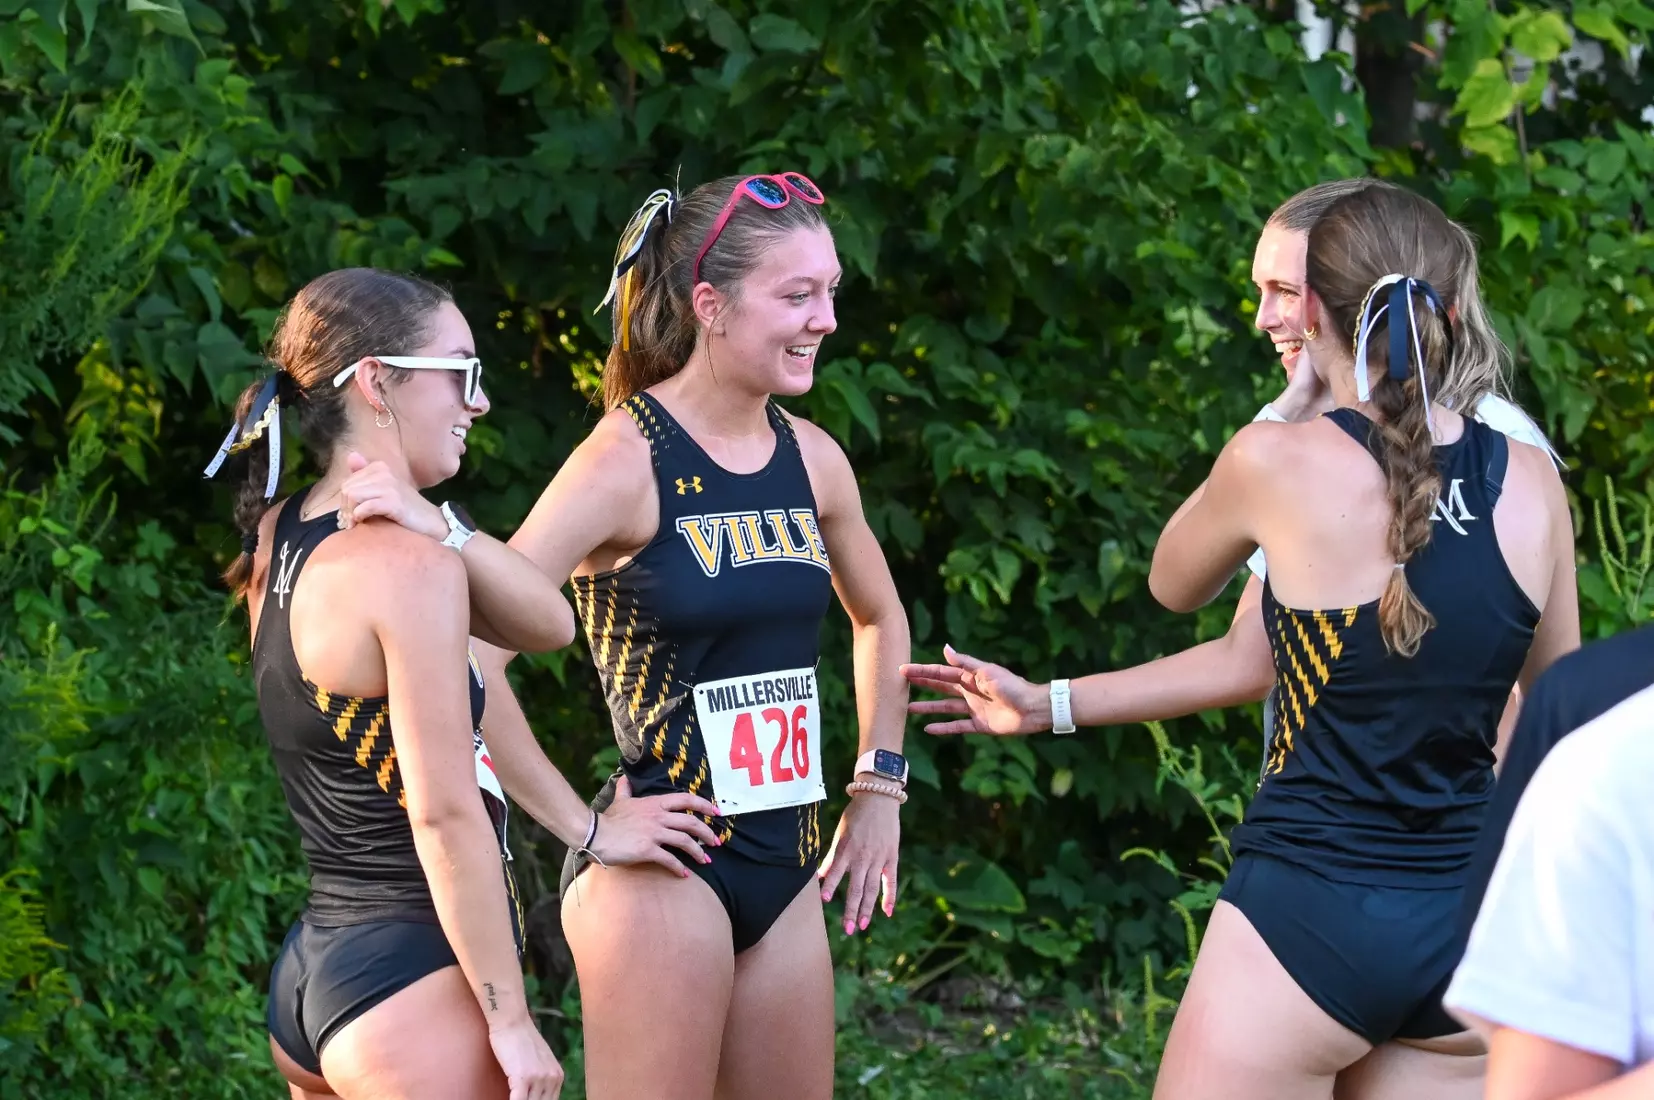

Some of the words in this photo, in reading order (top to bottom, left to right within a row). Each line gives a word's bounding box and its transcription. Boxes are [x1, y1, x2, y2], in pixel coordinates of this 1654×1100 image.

[675, 508, 832, 578] VILLE
[706, 674, 813, 713] MILLERSVILLE
[729, 704, 810, 787] 426
